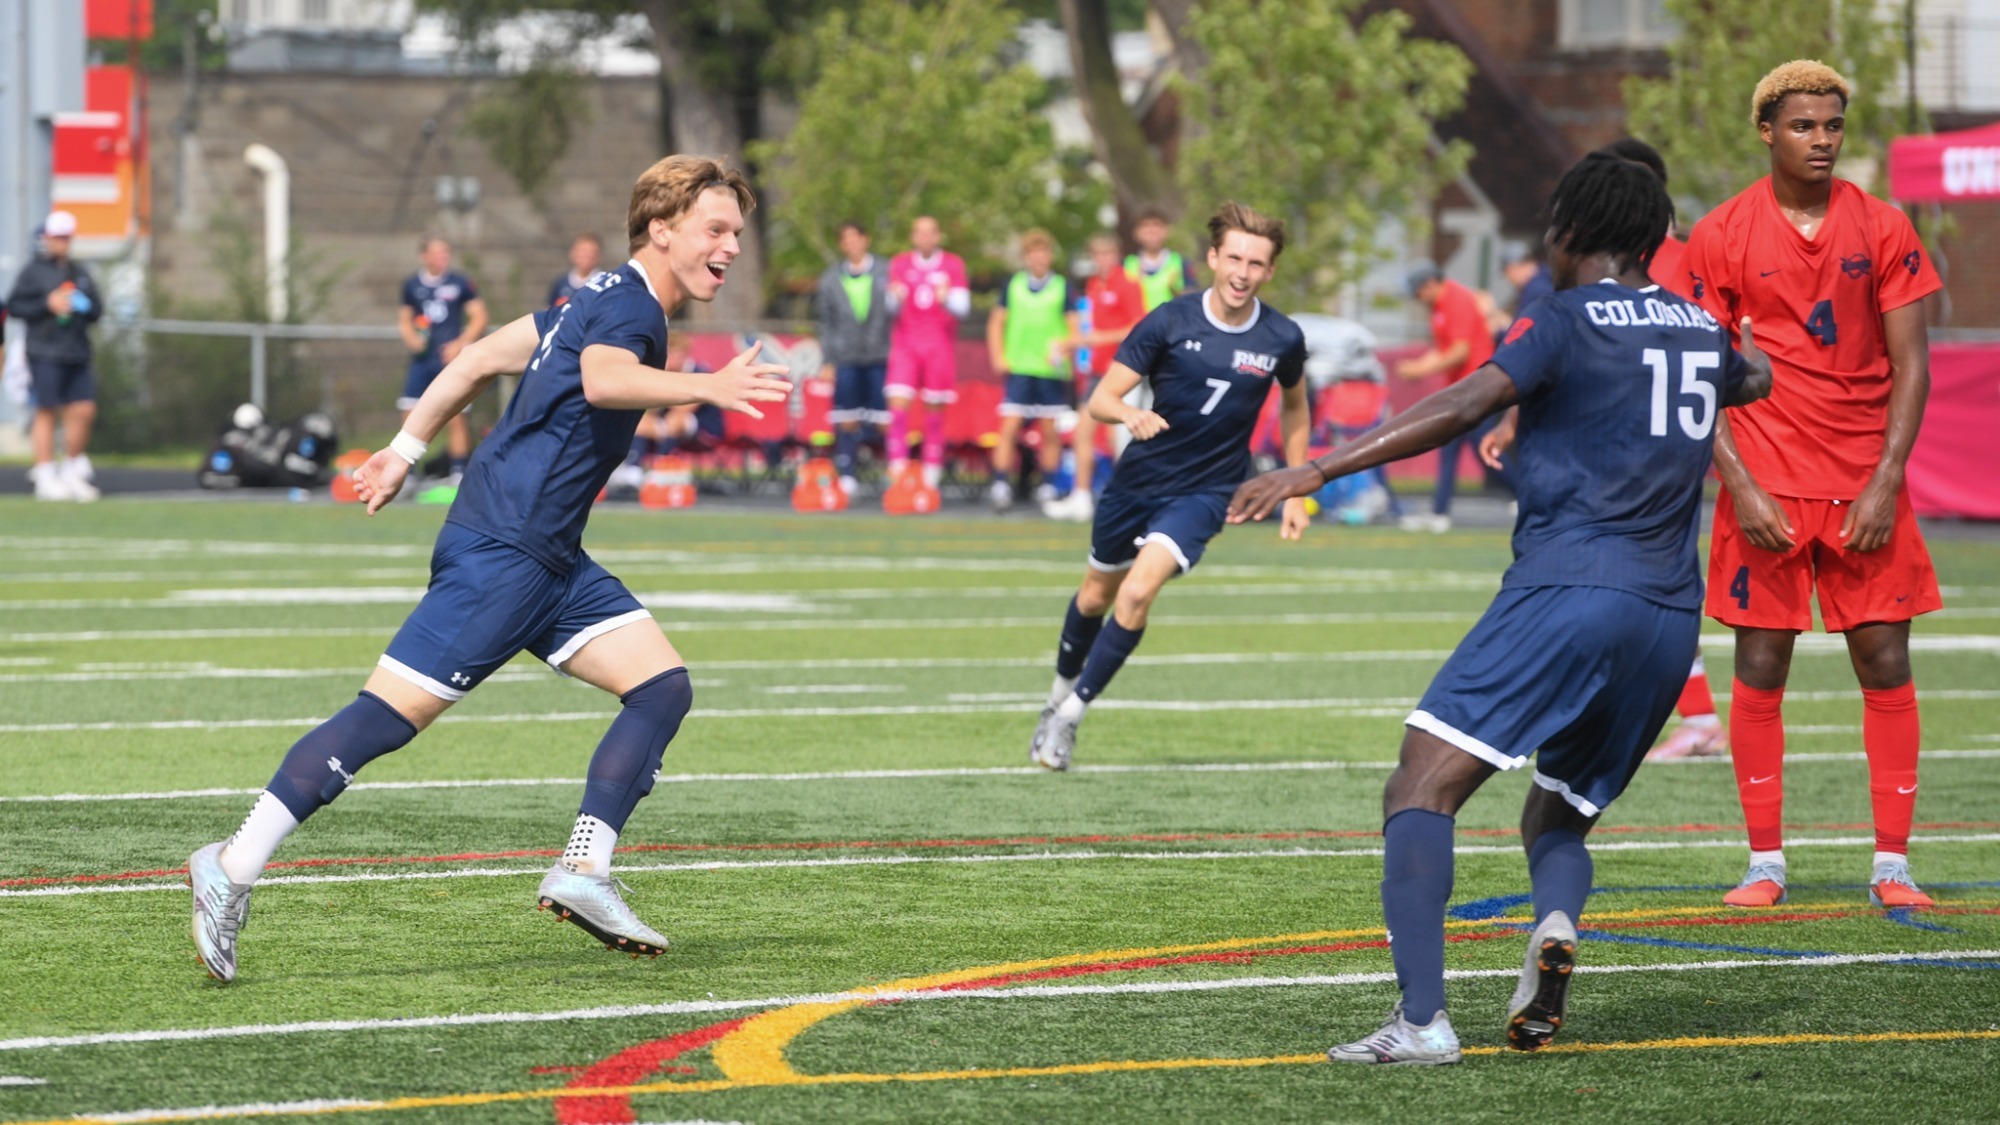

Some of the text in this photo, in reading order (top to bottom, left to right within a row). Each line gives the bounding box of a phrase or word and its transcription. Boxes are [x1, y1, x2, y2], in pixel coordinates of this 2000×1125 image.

[1941, 147, 2000, 196] UN
[1805, 299, 1838, 346] 4
[1231, 349, 1278, 373] RMU
[1199, 377, 1232, 416] 7
[1641, 347, 1721, 441] 15
[1729, 565, 1750, 611] 4
